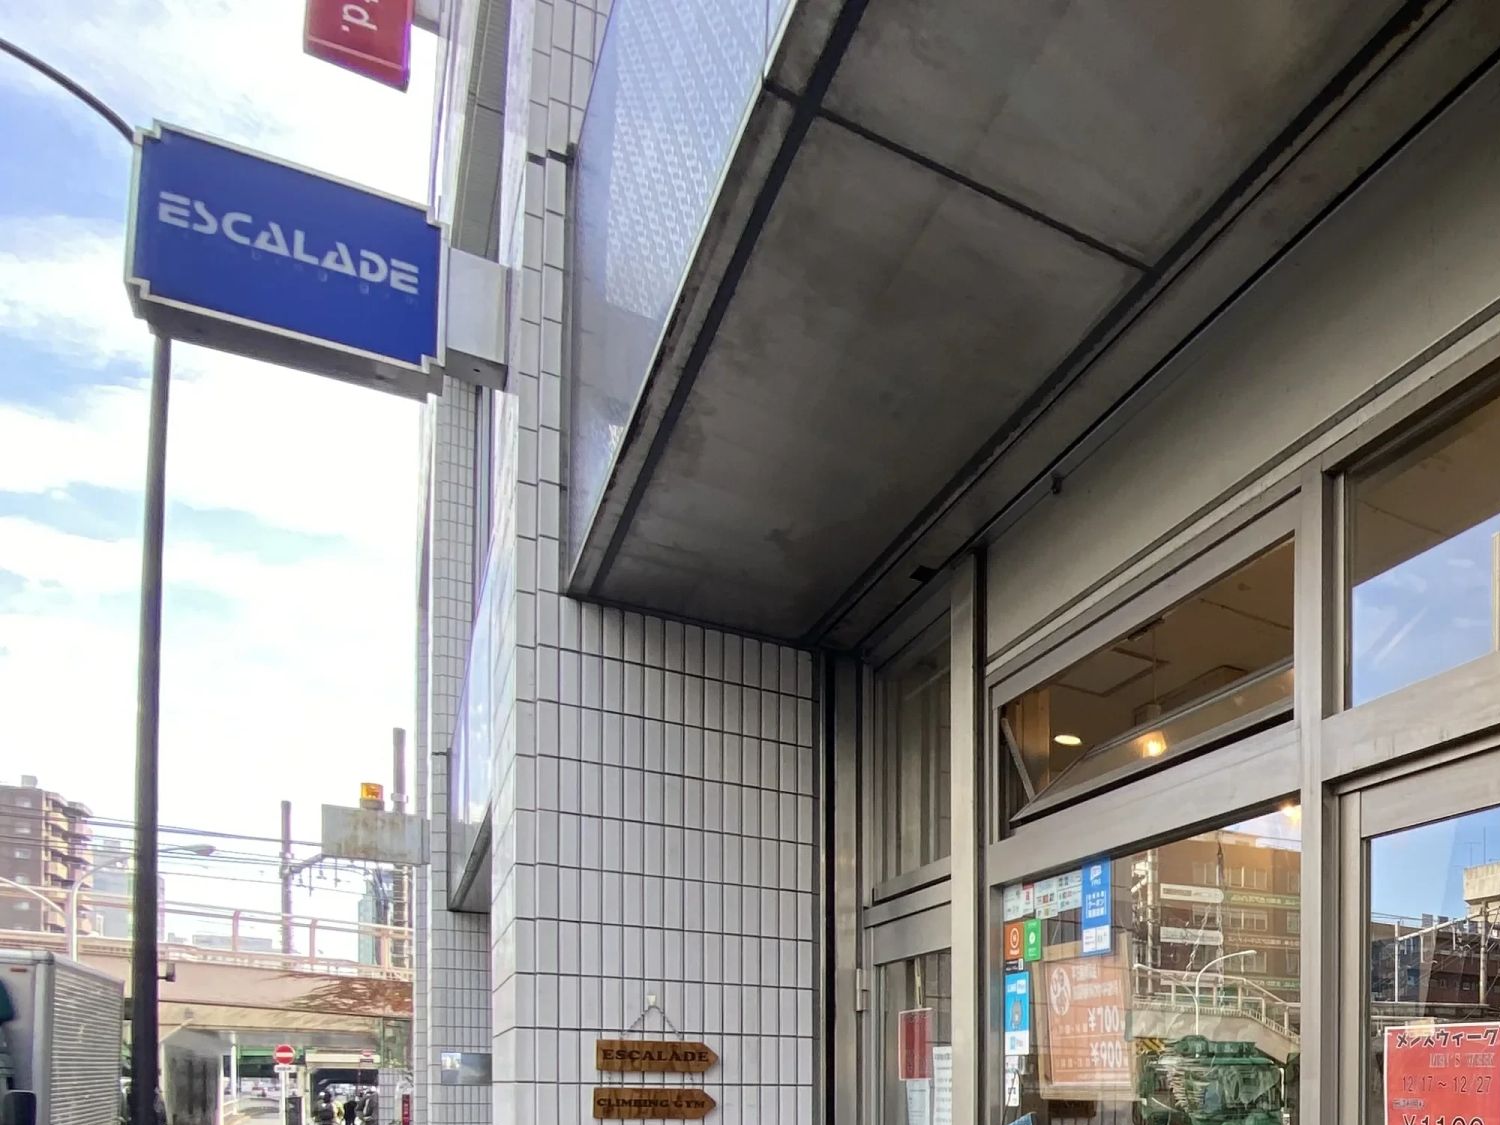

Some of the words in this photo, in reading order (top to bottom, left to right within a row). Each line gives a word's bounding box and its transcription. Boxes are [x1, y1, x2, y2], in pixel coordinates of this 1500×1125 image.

[158, 190, 420, 295] ESCALADE
[602, 1048, 709, 1063] ESCALADE
[596, 1098, 670, 1109] CLIMBING
[673, 1099, 706, 1110] GYM
